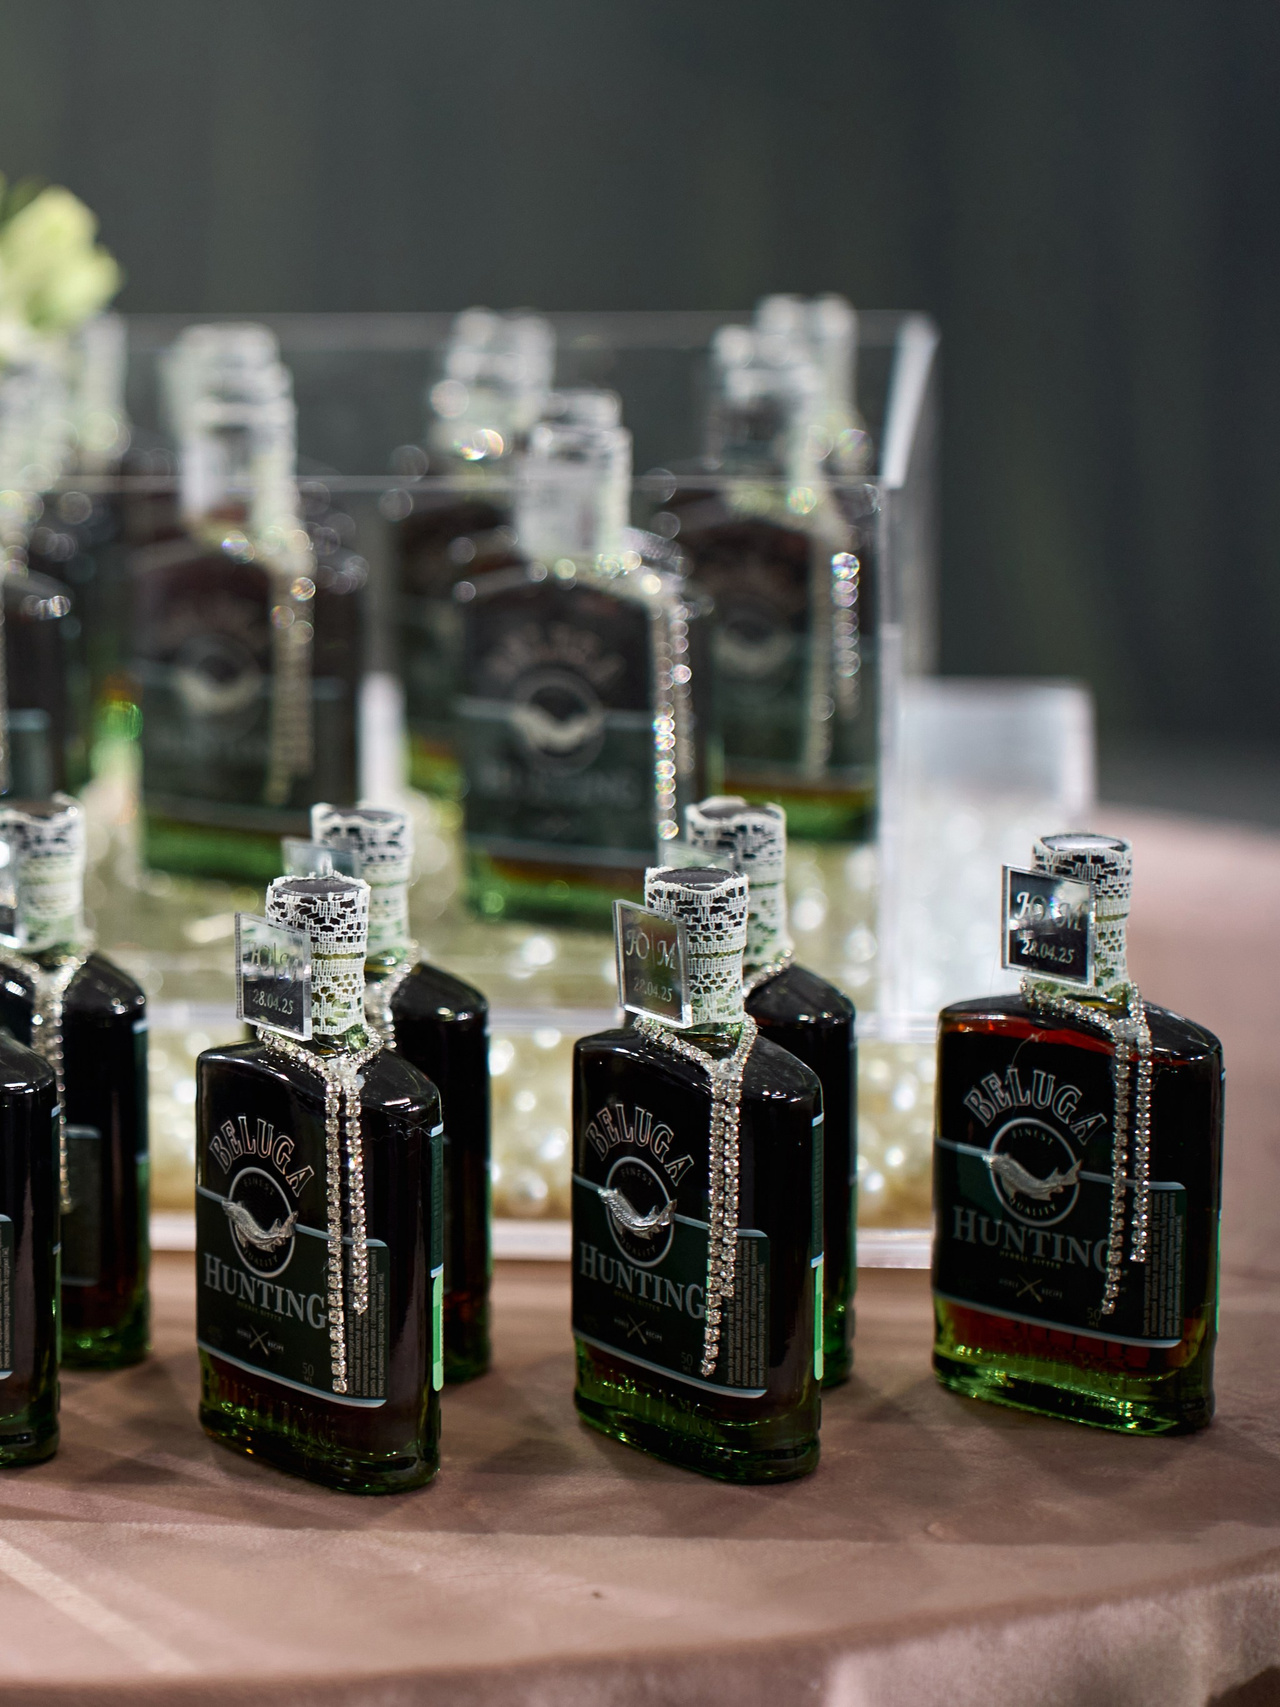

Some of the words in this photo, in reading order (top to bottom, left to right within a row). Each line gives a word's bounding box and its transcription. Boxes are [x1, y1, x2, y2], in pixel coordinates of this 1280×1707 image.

[1021, 939, 1075, 964] 28.04.25
[252, 987, 295, 1015] 28.04.25
[585, 1103, 695, 1187] BELUGA
[963, 1066, 1108, 1146] BELUGA
[209, 1115, 315, 1197] BELUGA
[204, 1252, 328, 1330] HUNTING
[579, 1241, 706, 1320] HUNTING
[301, 1362, 315, 1377] 50
